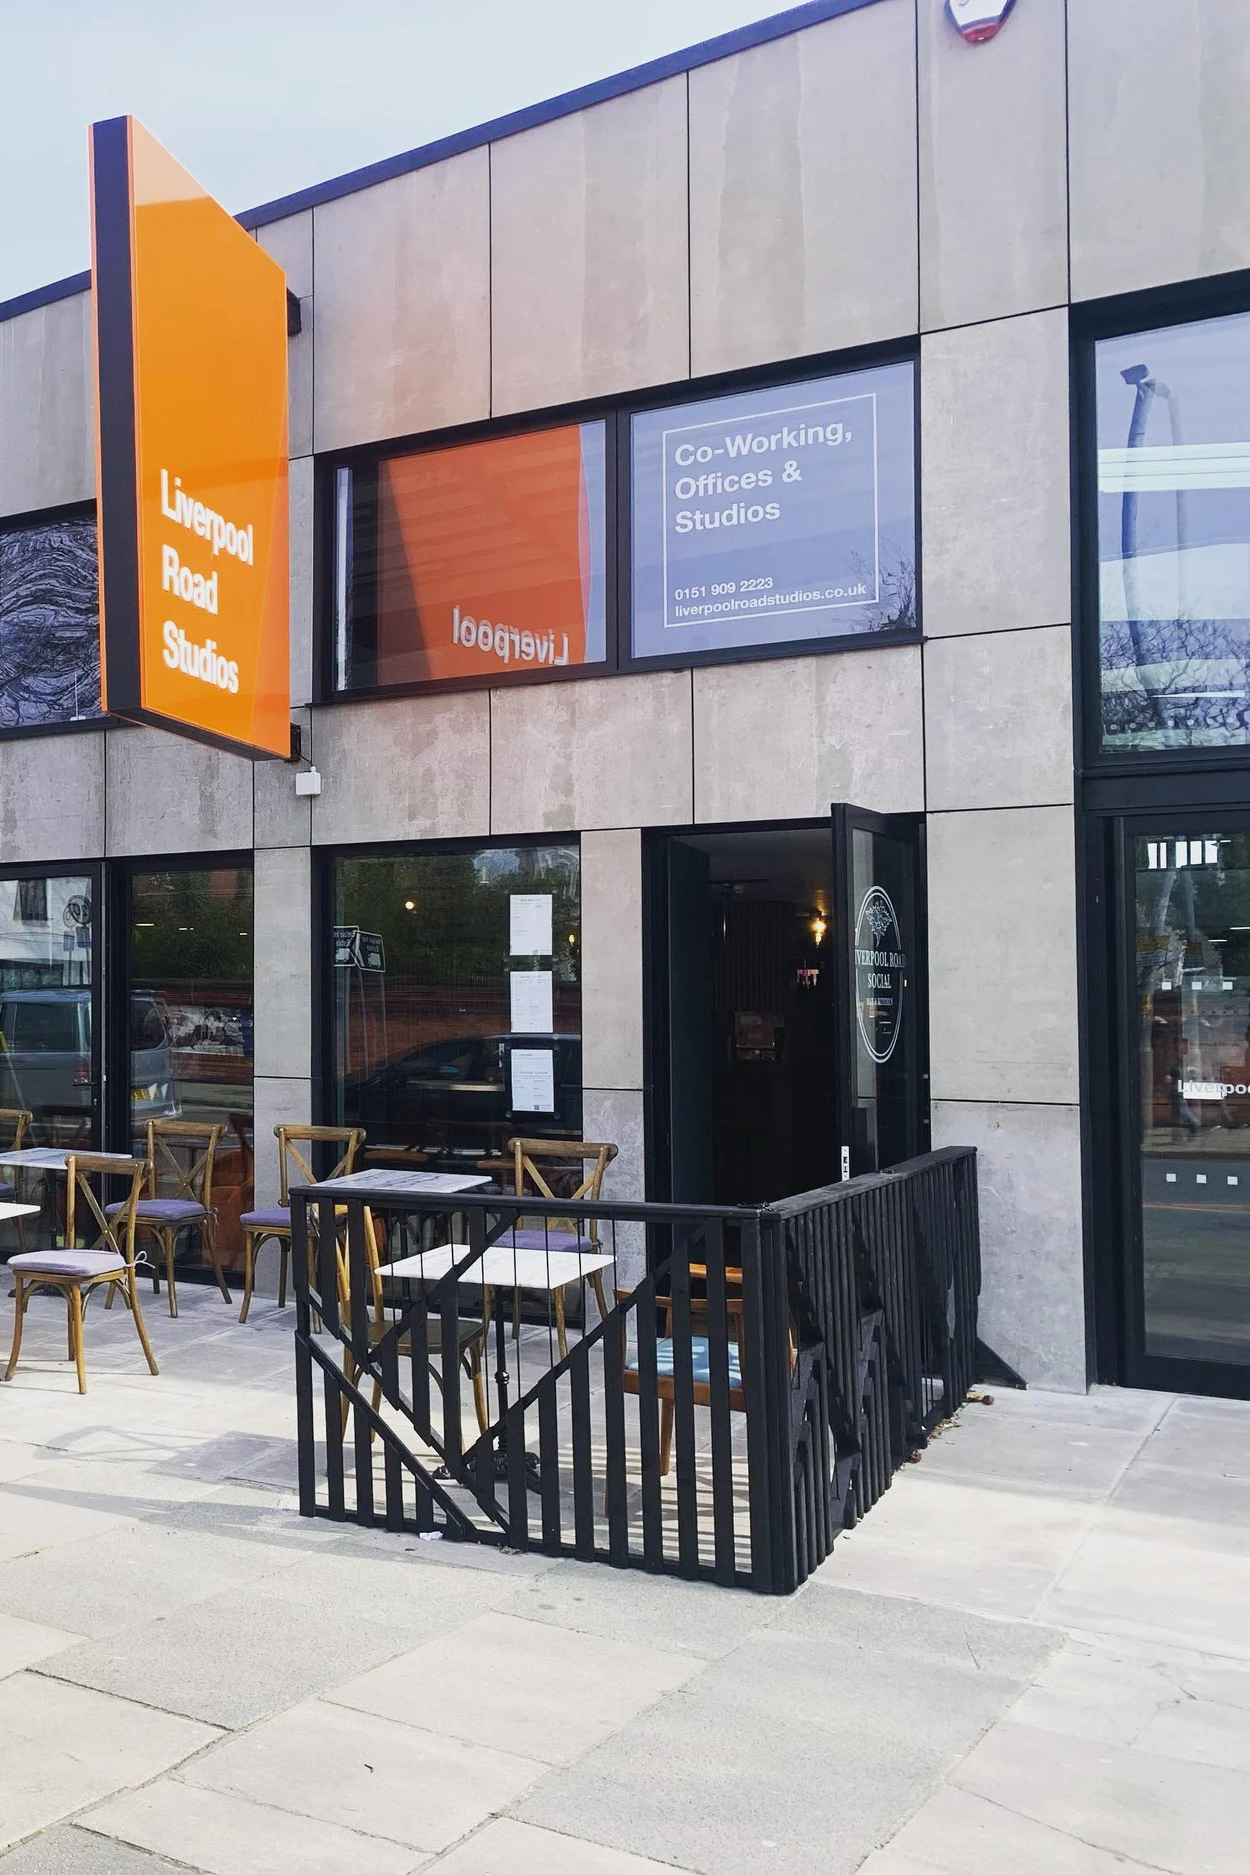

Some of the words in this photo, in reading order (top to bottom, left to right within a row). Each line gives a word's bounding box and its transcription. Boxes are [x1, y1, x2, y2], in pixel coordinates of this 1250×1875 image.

[674, 422, 853, 467] Co-Working,
[674, 469, 774, 501] Offices
[781, 460, 803, 484] &
[160, 467, 254, 568] Liverpool
[674, 502, 782, 534] Studios
[161, 543, 219, 617] Road
[674, 586, 707, 601] 0151
[711, 581, 737, 597] 909
[739, 577, 774, 594] 2223
[674, 583, 868, 618] liverpoolroadstudios.co.uk
[161, 620, 239, 694] Studios
[867, 972, 892, 989] SOCIAL
